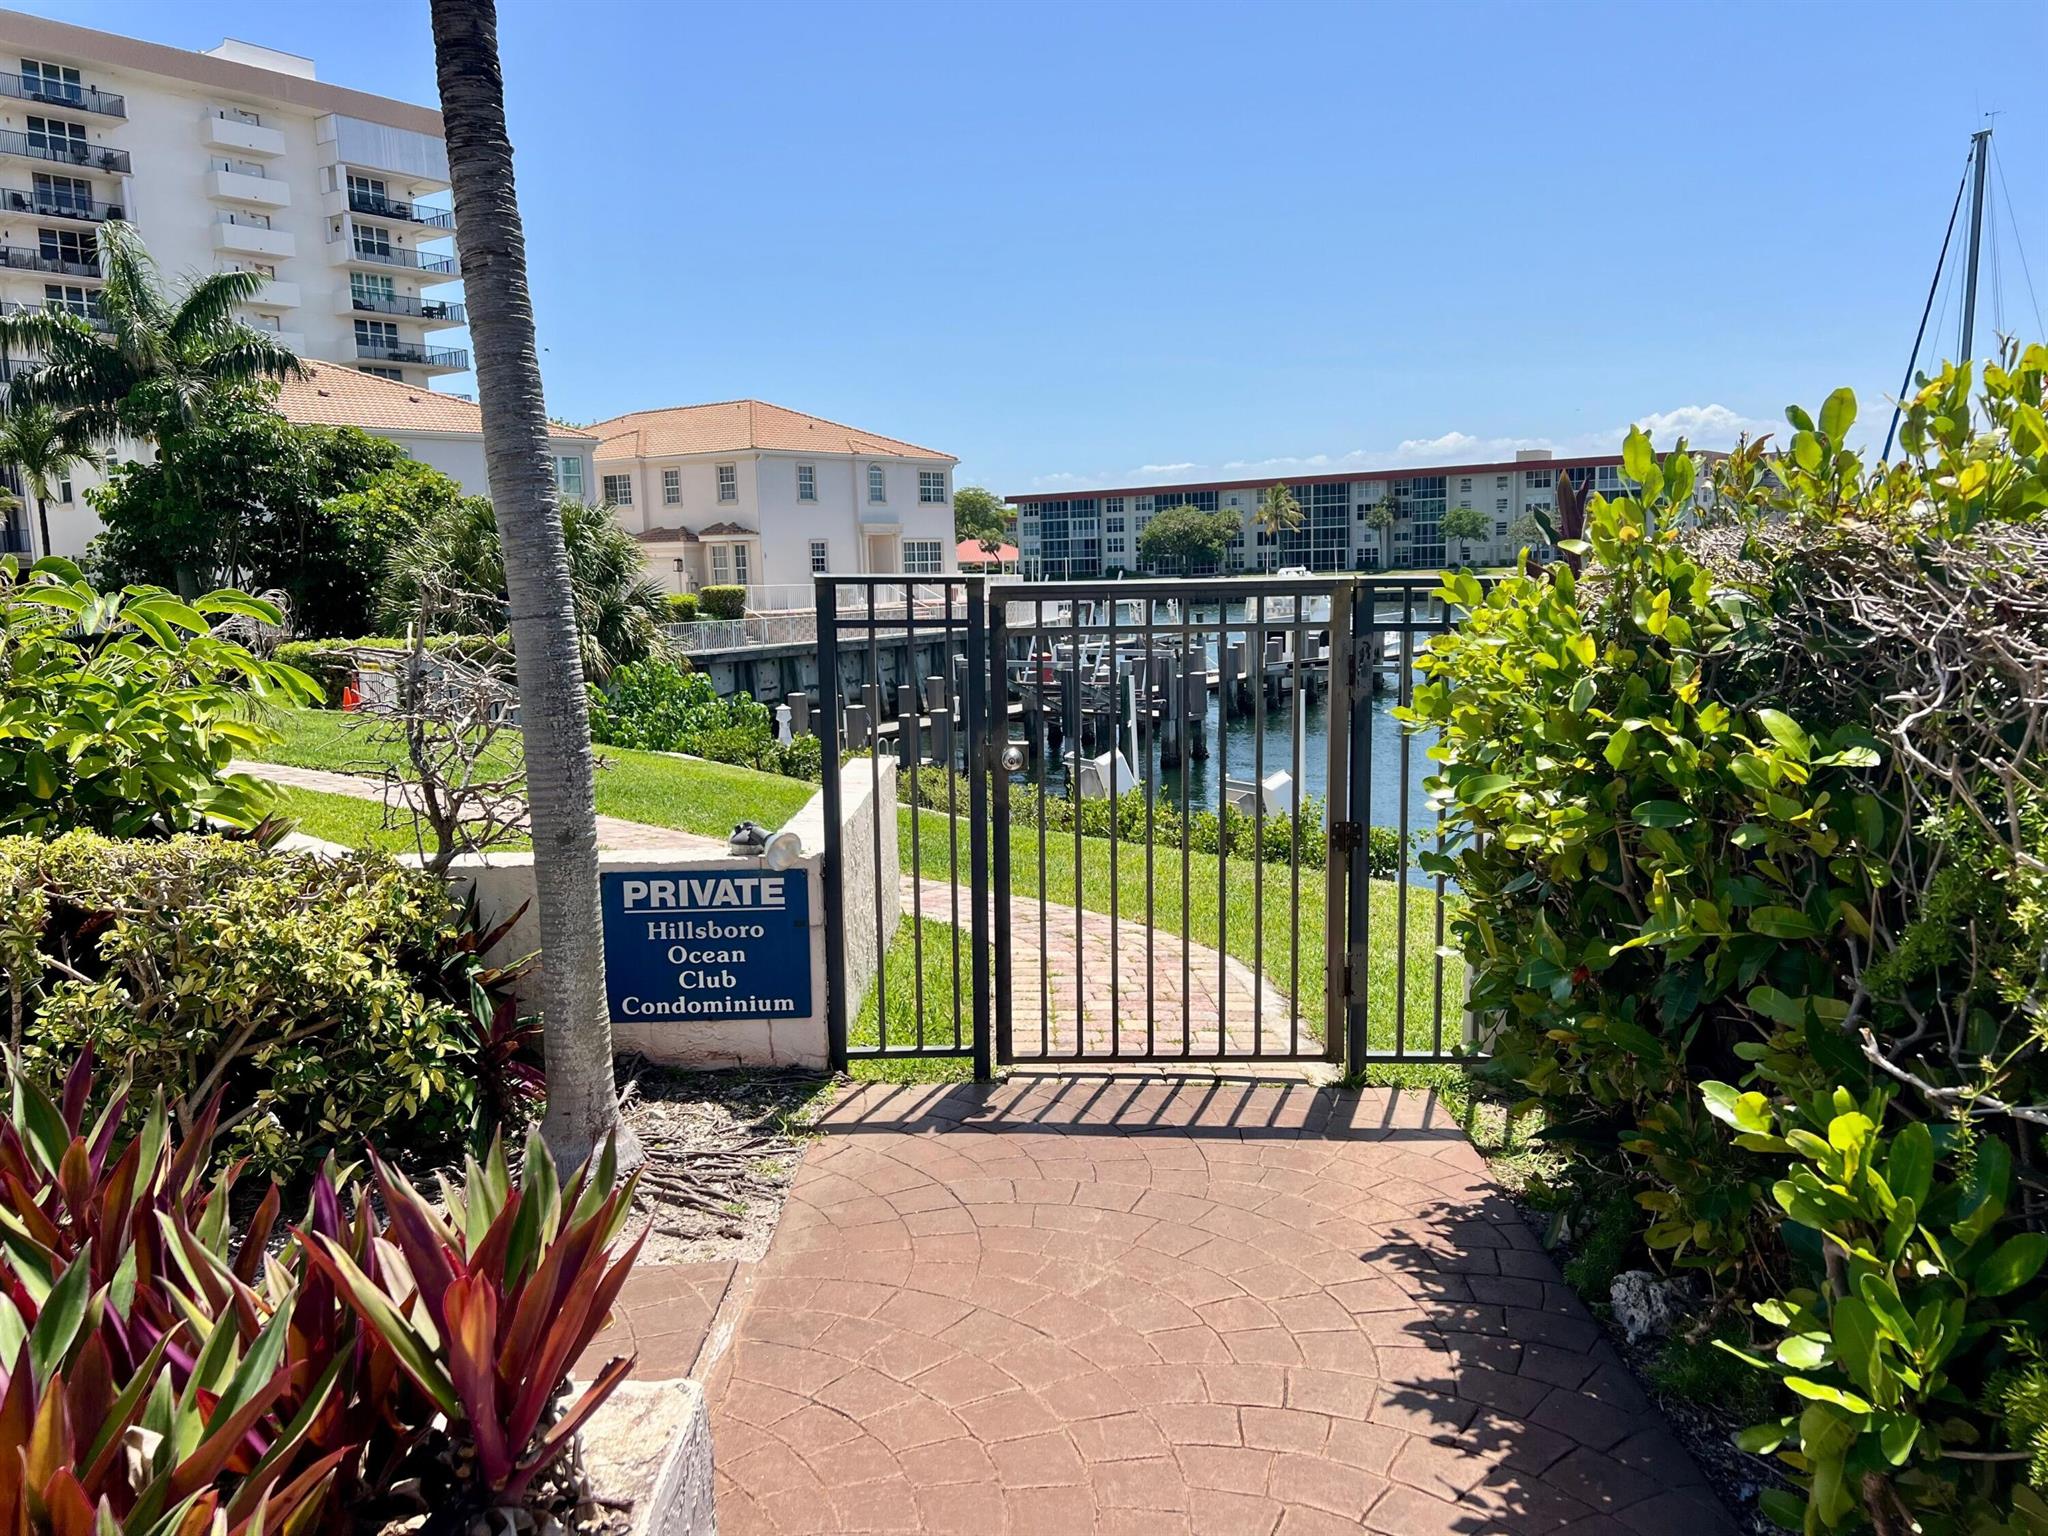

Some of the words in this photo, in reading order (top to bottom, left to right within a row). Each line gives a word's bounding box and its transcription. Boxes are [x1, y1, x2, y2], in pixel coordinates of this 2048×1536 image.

[623, 877, 786, 908] PRIVATE
[647, 920, 765, 940] Hillsboro
[667, 945, 746, 964] Ocean
[678, 969, 737, 989] Club
[621, 995, 795, 1015] Condominium
